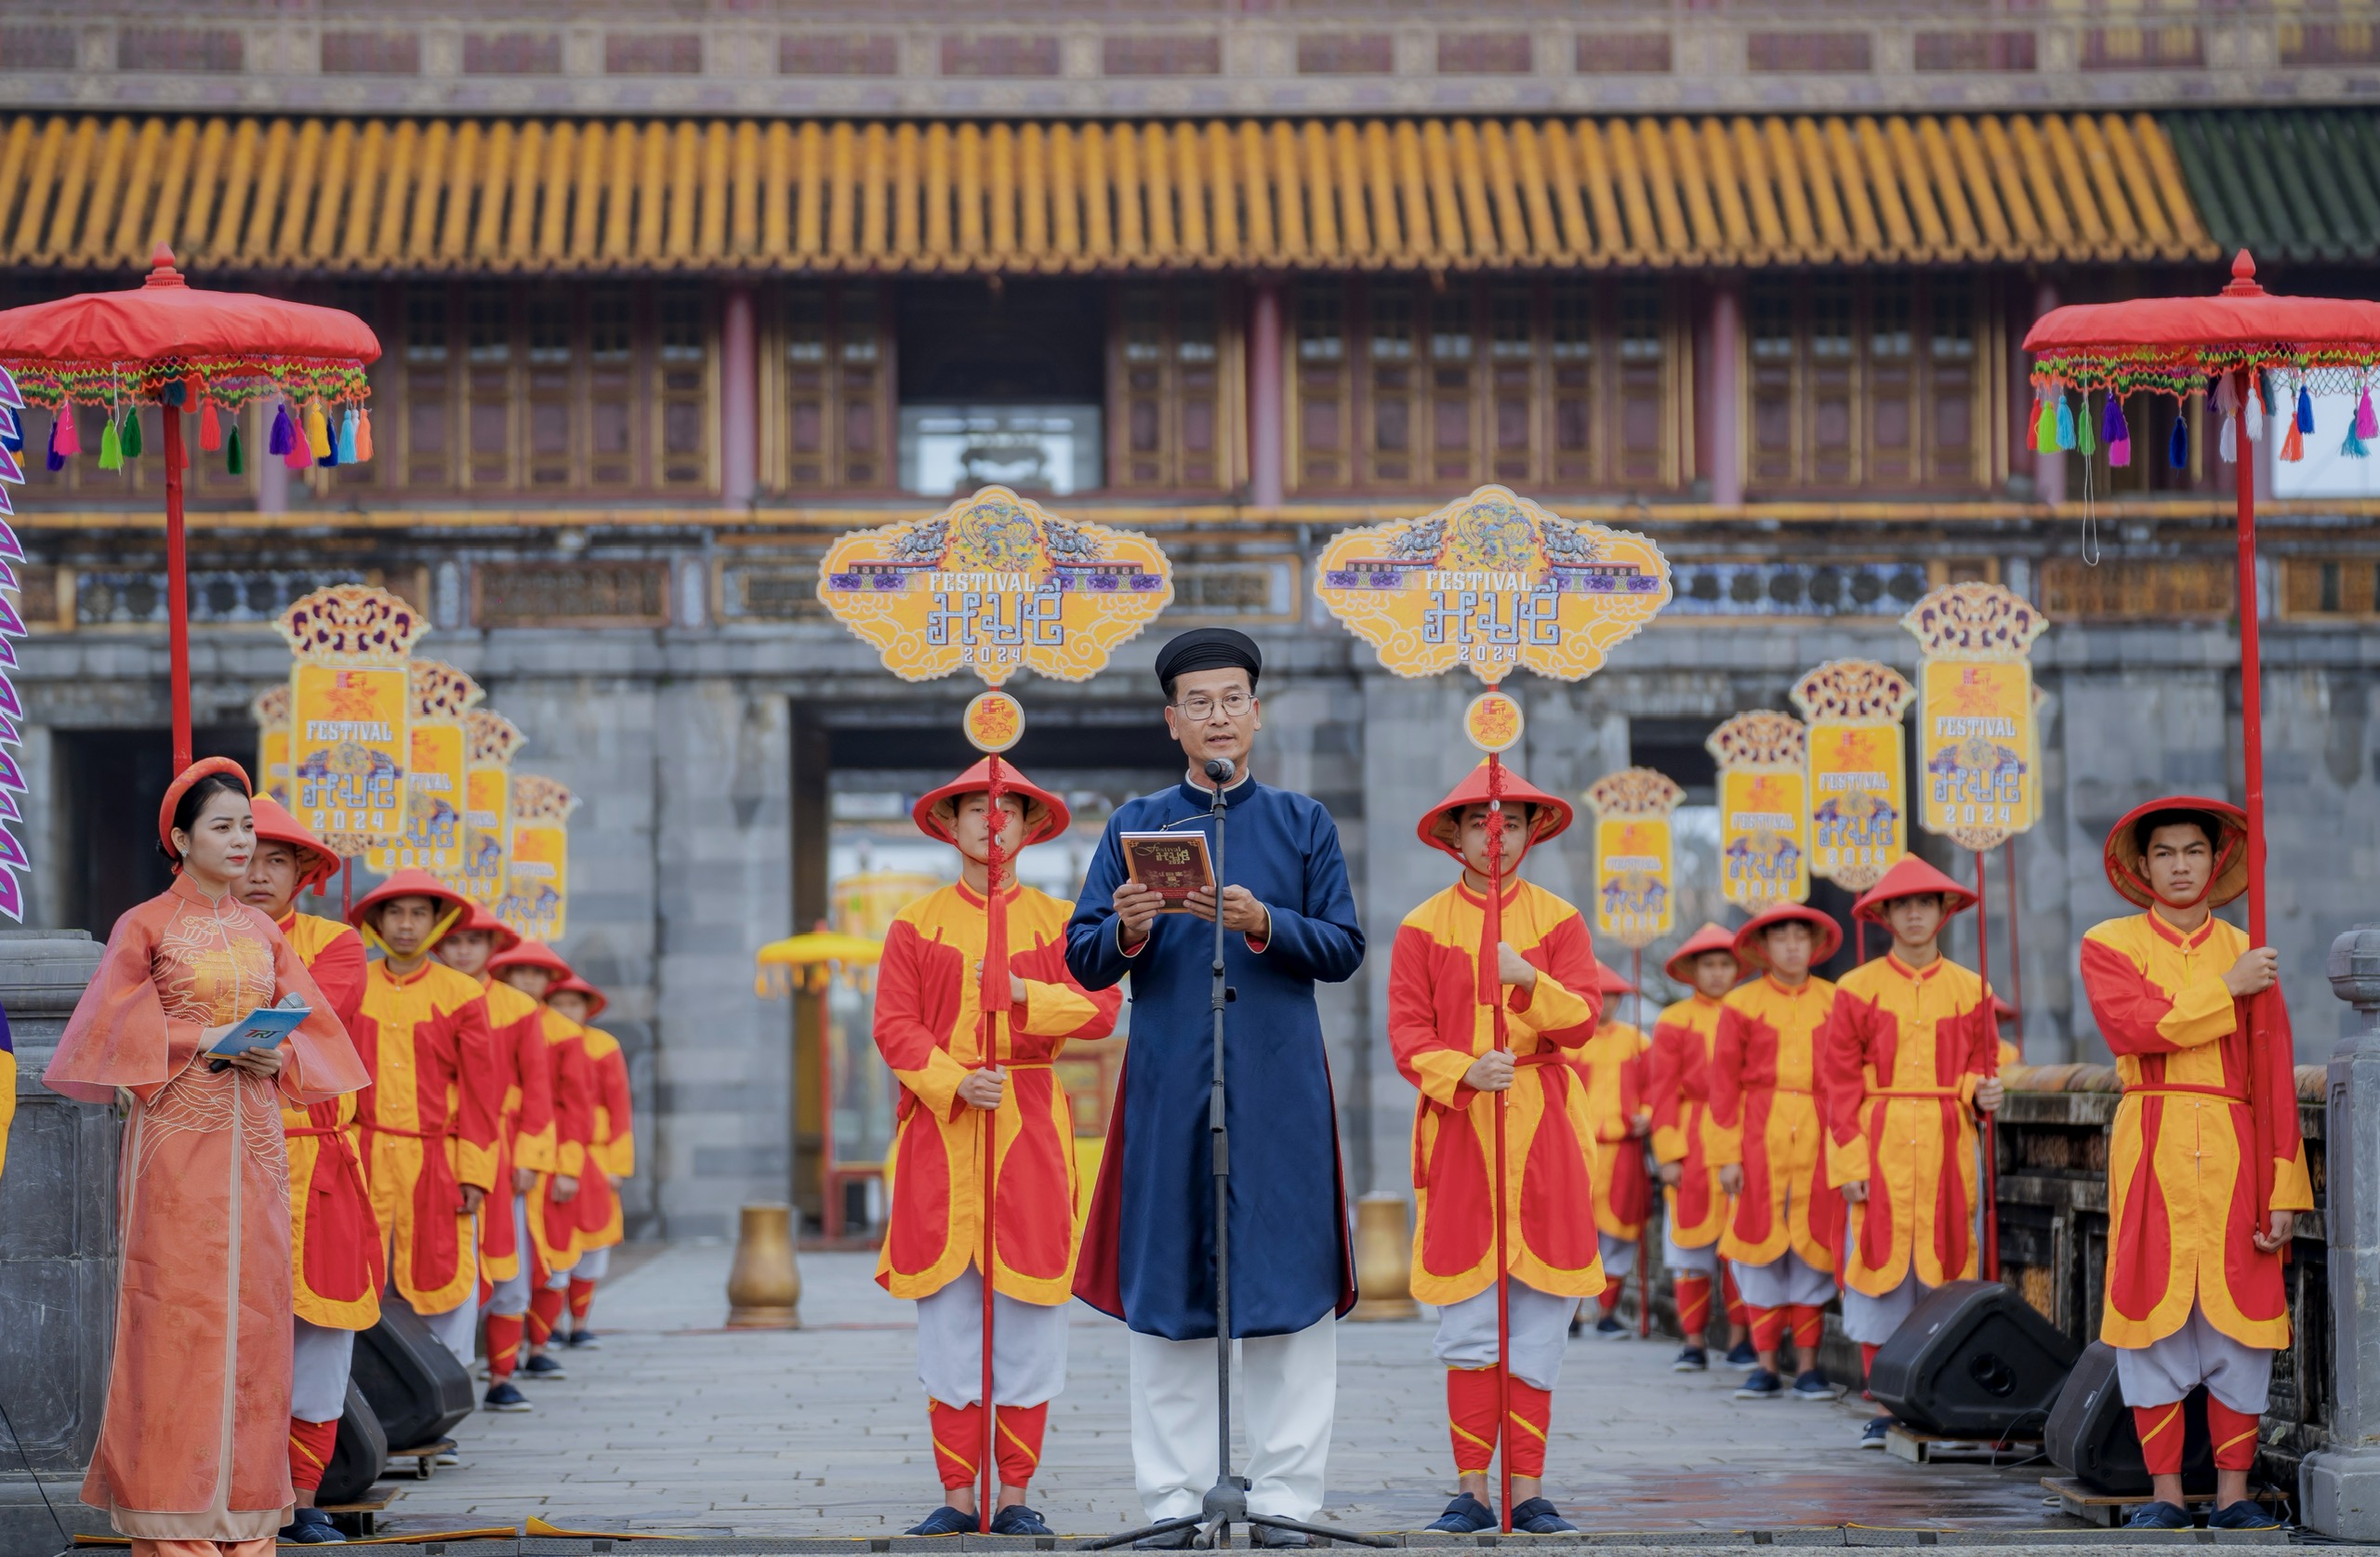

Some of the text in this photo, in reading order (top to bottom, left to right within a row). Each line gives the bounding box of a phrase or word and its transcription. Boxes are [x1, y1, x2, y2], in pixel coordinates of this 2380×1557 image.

[930, 572, 1036, 592] FESTIVAL
[1426, 571, 1533, 591] FESTIVAL
[963, 647, 1022, 663] 2024
[1460, 645, 1517, 662] 2024
[306, 720, 392, 741] FESTIVAL
[1937, 717, 2016, 737] FESTIVAL
[1819, 772, 1890, 790] FESTIVAL
[312, 810, 384, 829] 2024
[1945, 804, 2011, 823] 2024
[1135, 842, 1182, 856] Festival
